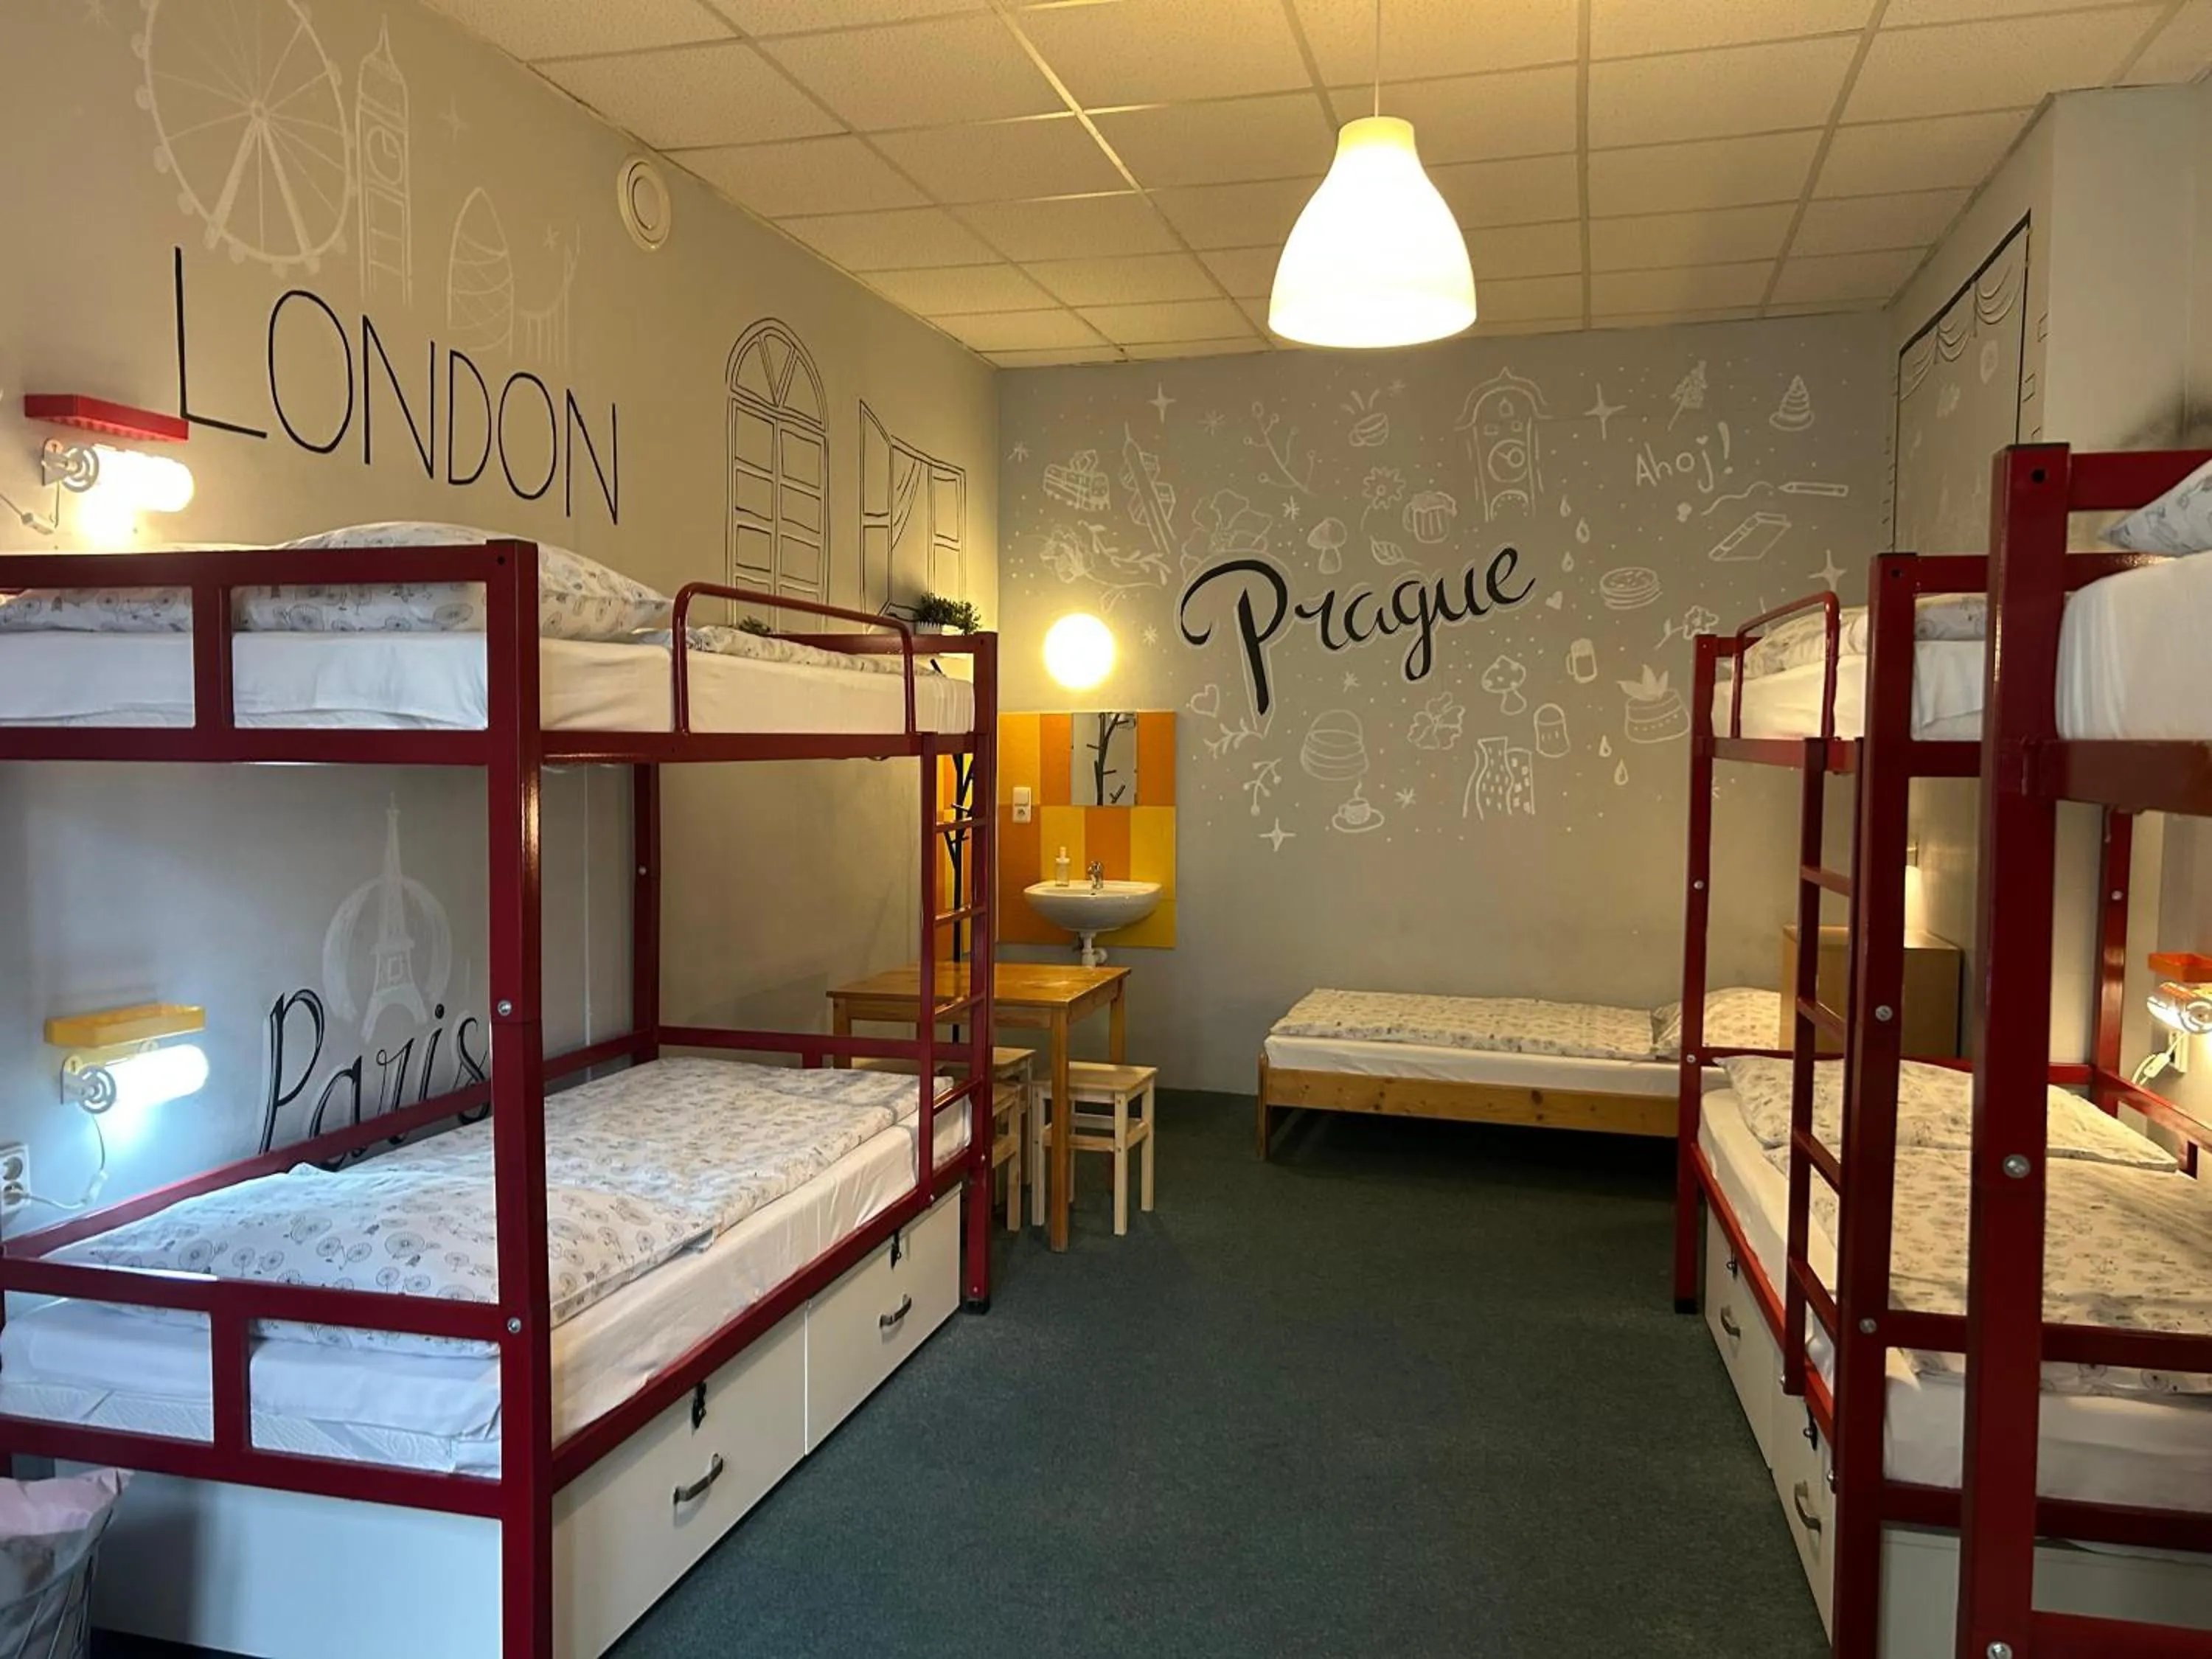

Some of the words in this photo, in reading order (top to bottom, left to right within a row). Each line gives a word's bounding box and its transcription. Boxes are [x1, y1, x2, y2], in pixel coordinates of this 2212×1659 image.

[175, 246, 618, 525] LONDON
[1636, 421, 1733, 493] Ahoj!
[1180, 547, 1536, 716] Prague
[259, 989, 489, 1172] Paris
